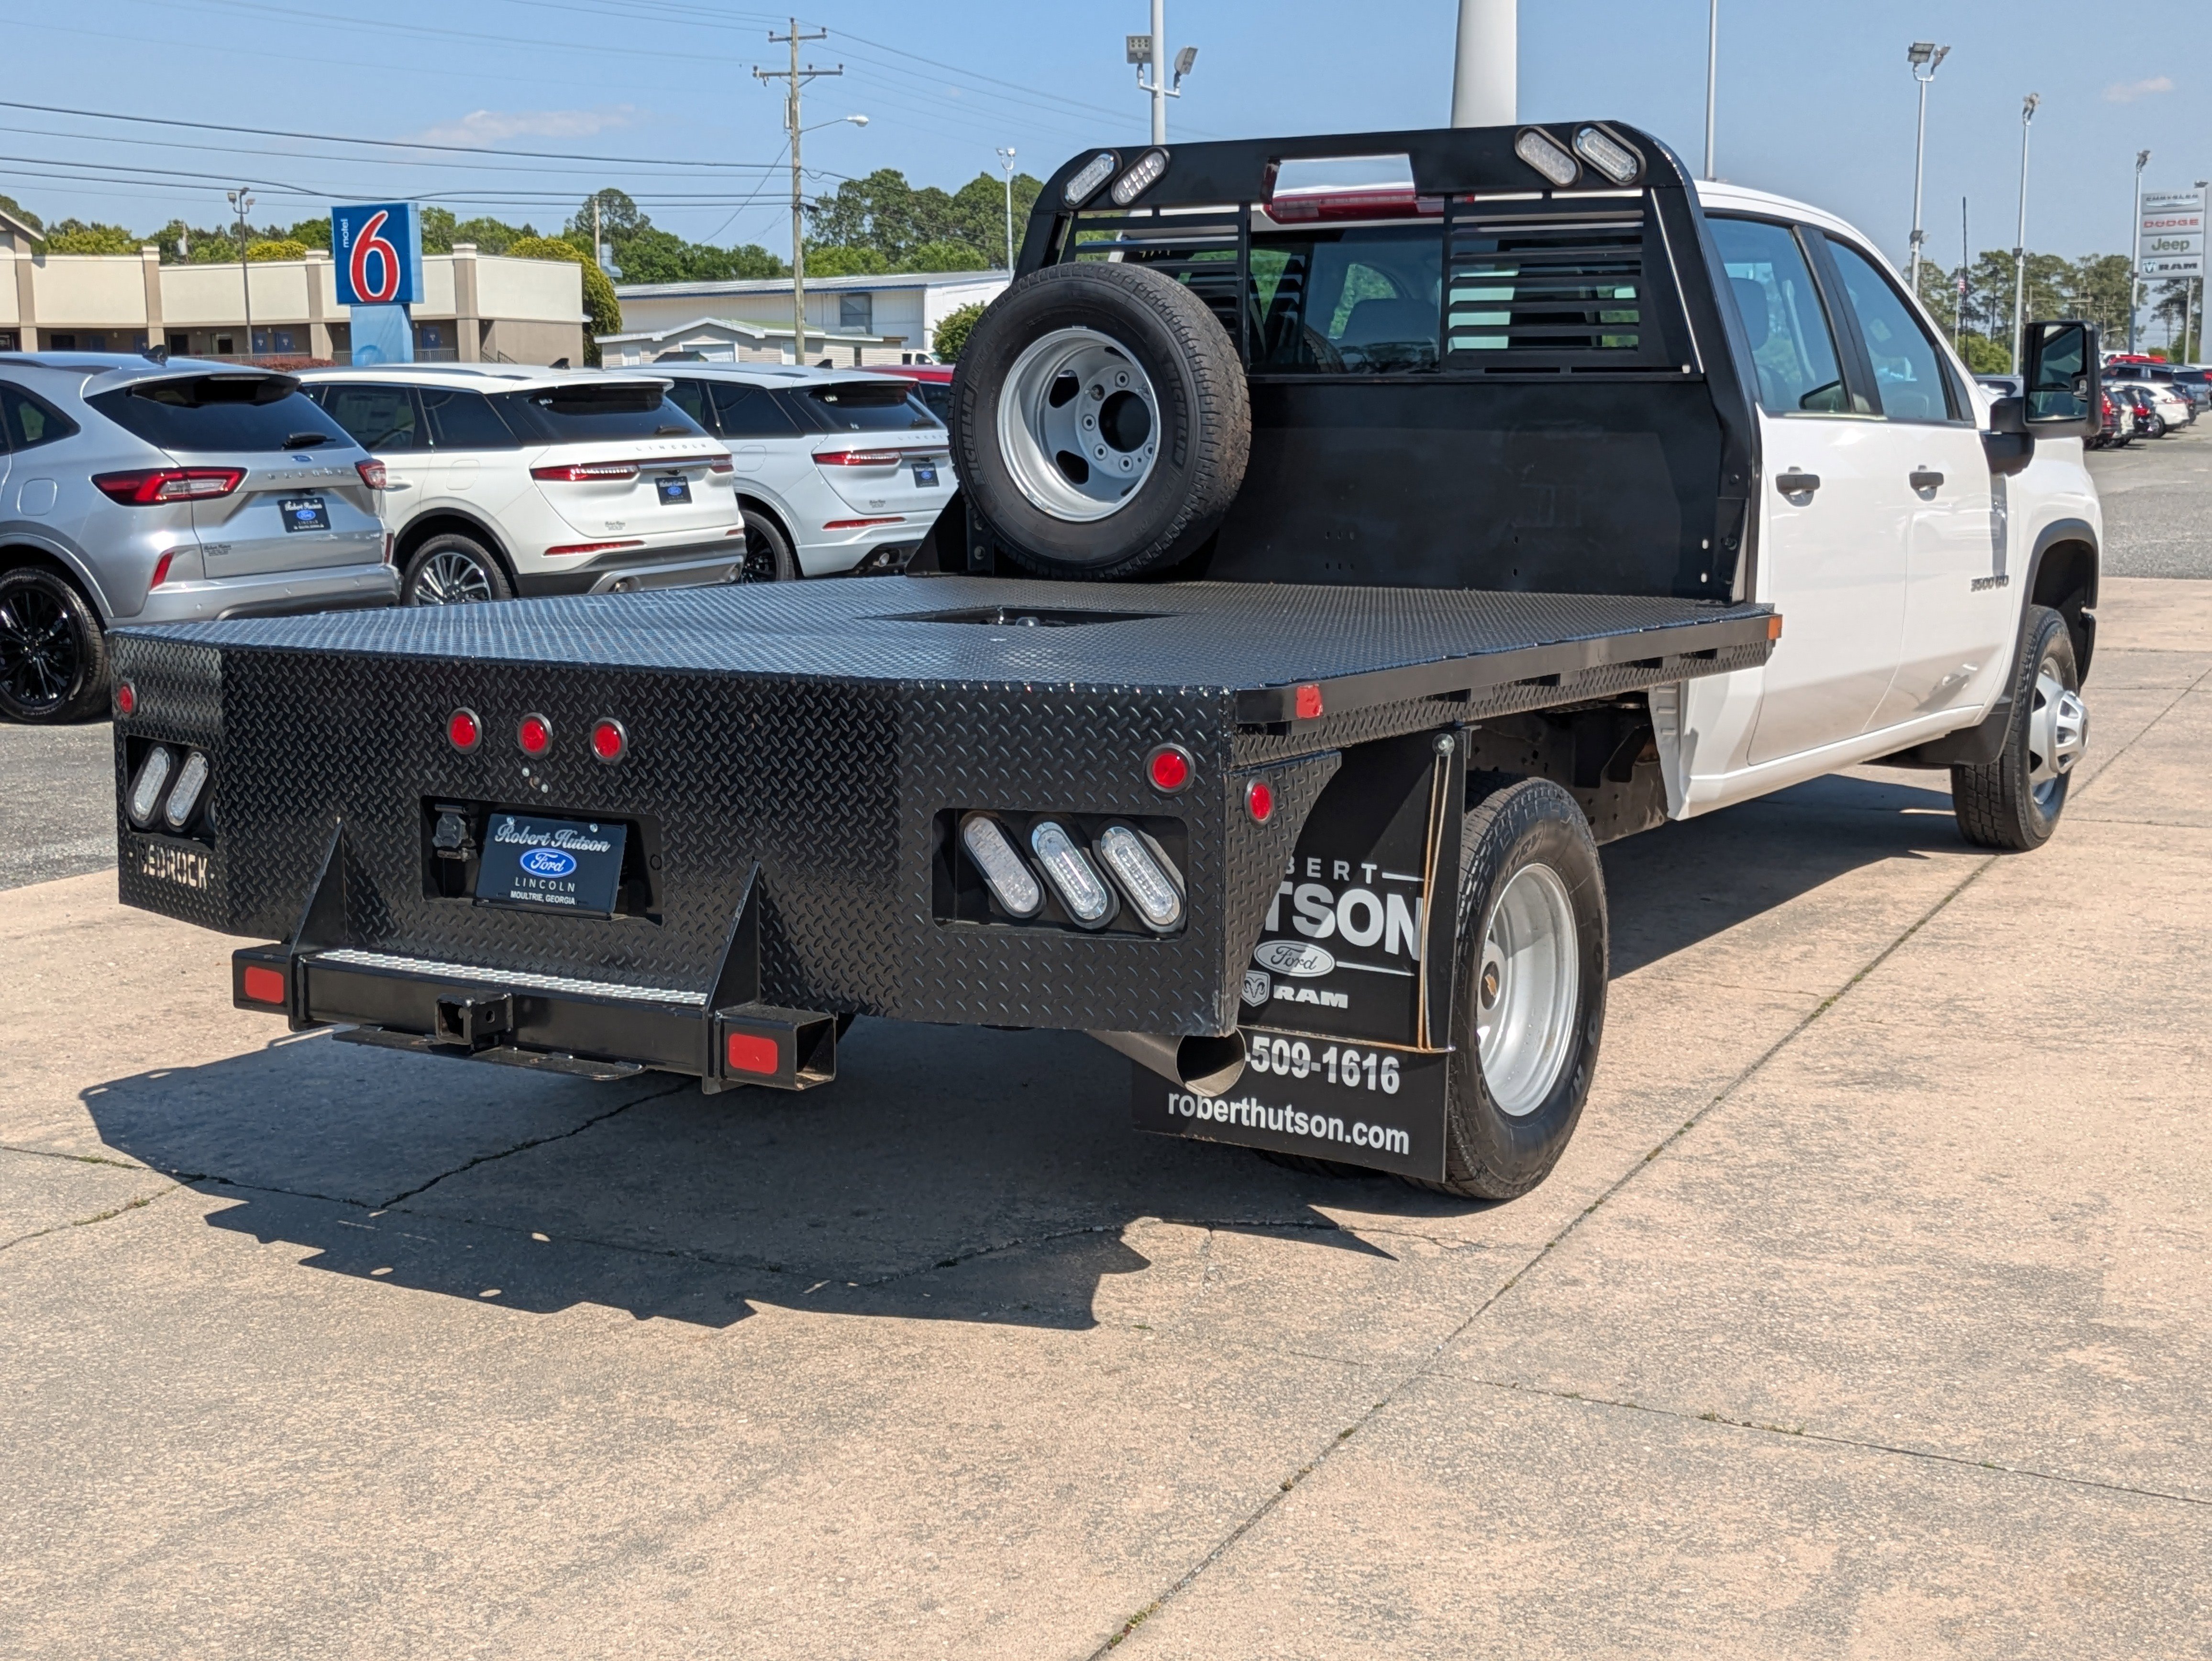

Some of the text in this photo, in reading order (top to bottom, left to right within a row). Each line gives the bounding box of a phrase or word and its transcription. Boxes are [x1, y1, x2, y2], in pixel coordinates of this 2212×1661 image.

[2144, 219, 2199, 228] DODGE
[341, 209, 401, 302] motel 6
[2152, 238, 2190, 252] Jeep
[2158, 263, 2198, 271] RAM
[961, 387, 986, 486] MICHELIN
[495, 822, 611, 853] Robert Hutson
[530, 852, 564, 872] Ford
[515, 877, 575, 892] LINCOLN
[510, 890, 575, 906] MOULTRIE, GEORGIA
[1270, 945, 1316, 971] Ford
[1273, 985, 1348, 1009] RAM
[1168, 1092, 1410, 1155] roberthutson.com
